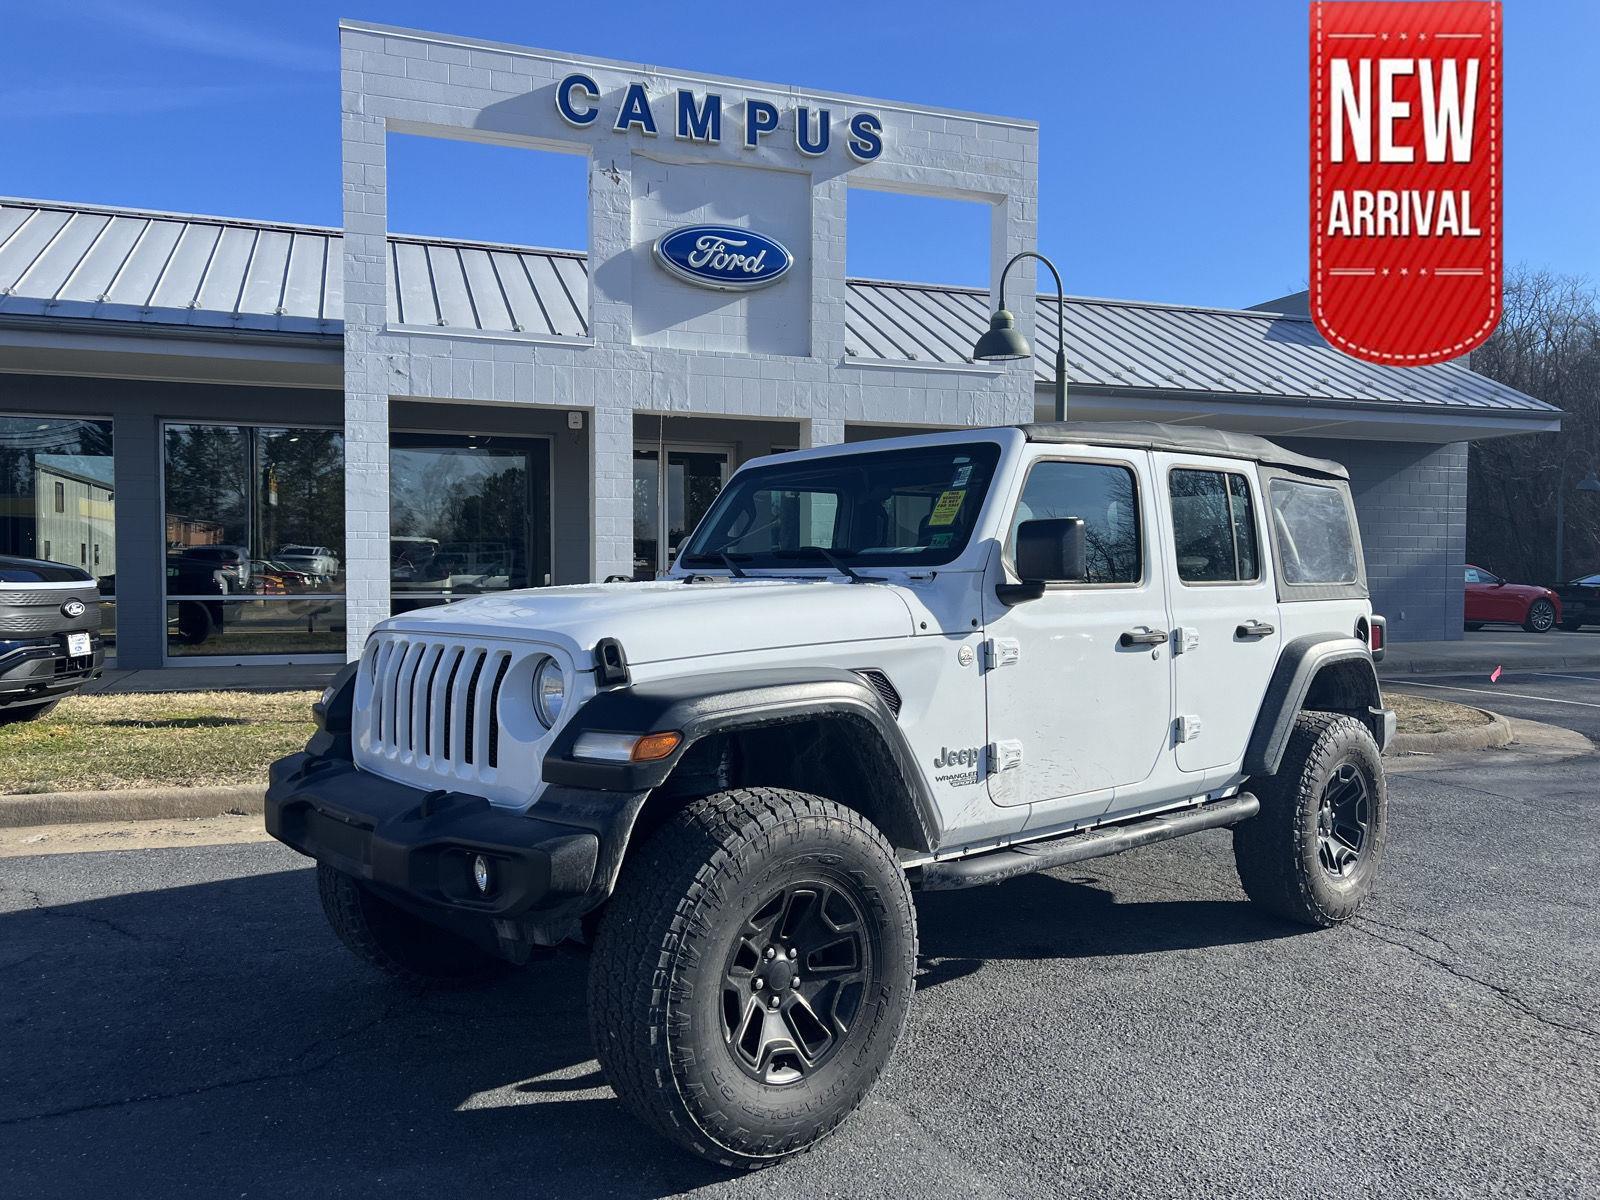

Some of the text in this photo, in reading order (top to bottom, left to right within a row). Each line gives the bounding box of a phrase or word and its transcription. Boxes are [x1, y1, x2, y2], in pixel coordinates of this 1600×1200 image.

[555, 73, 884, 163] CAMPUS
[688, 235, 767, 274] Ford
[934, 746, 979, 768] Jeep
[935, 771, 978, 782] WRANGLER
